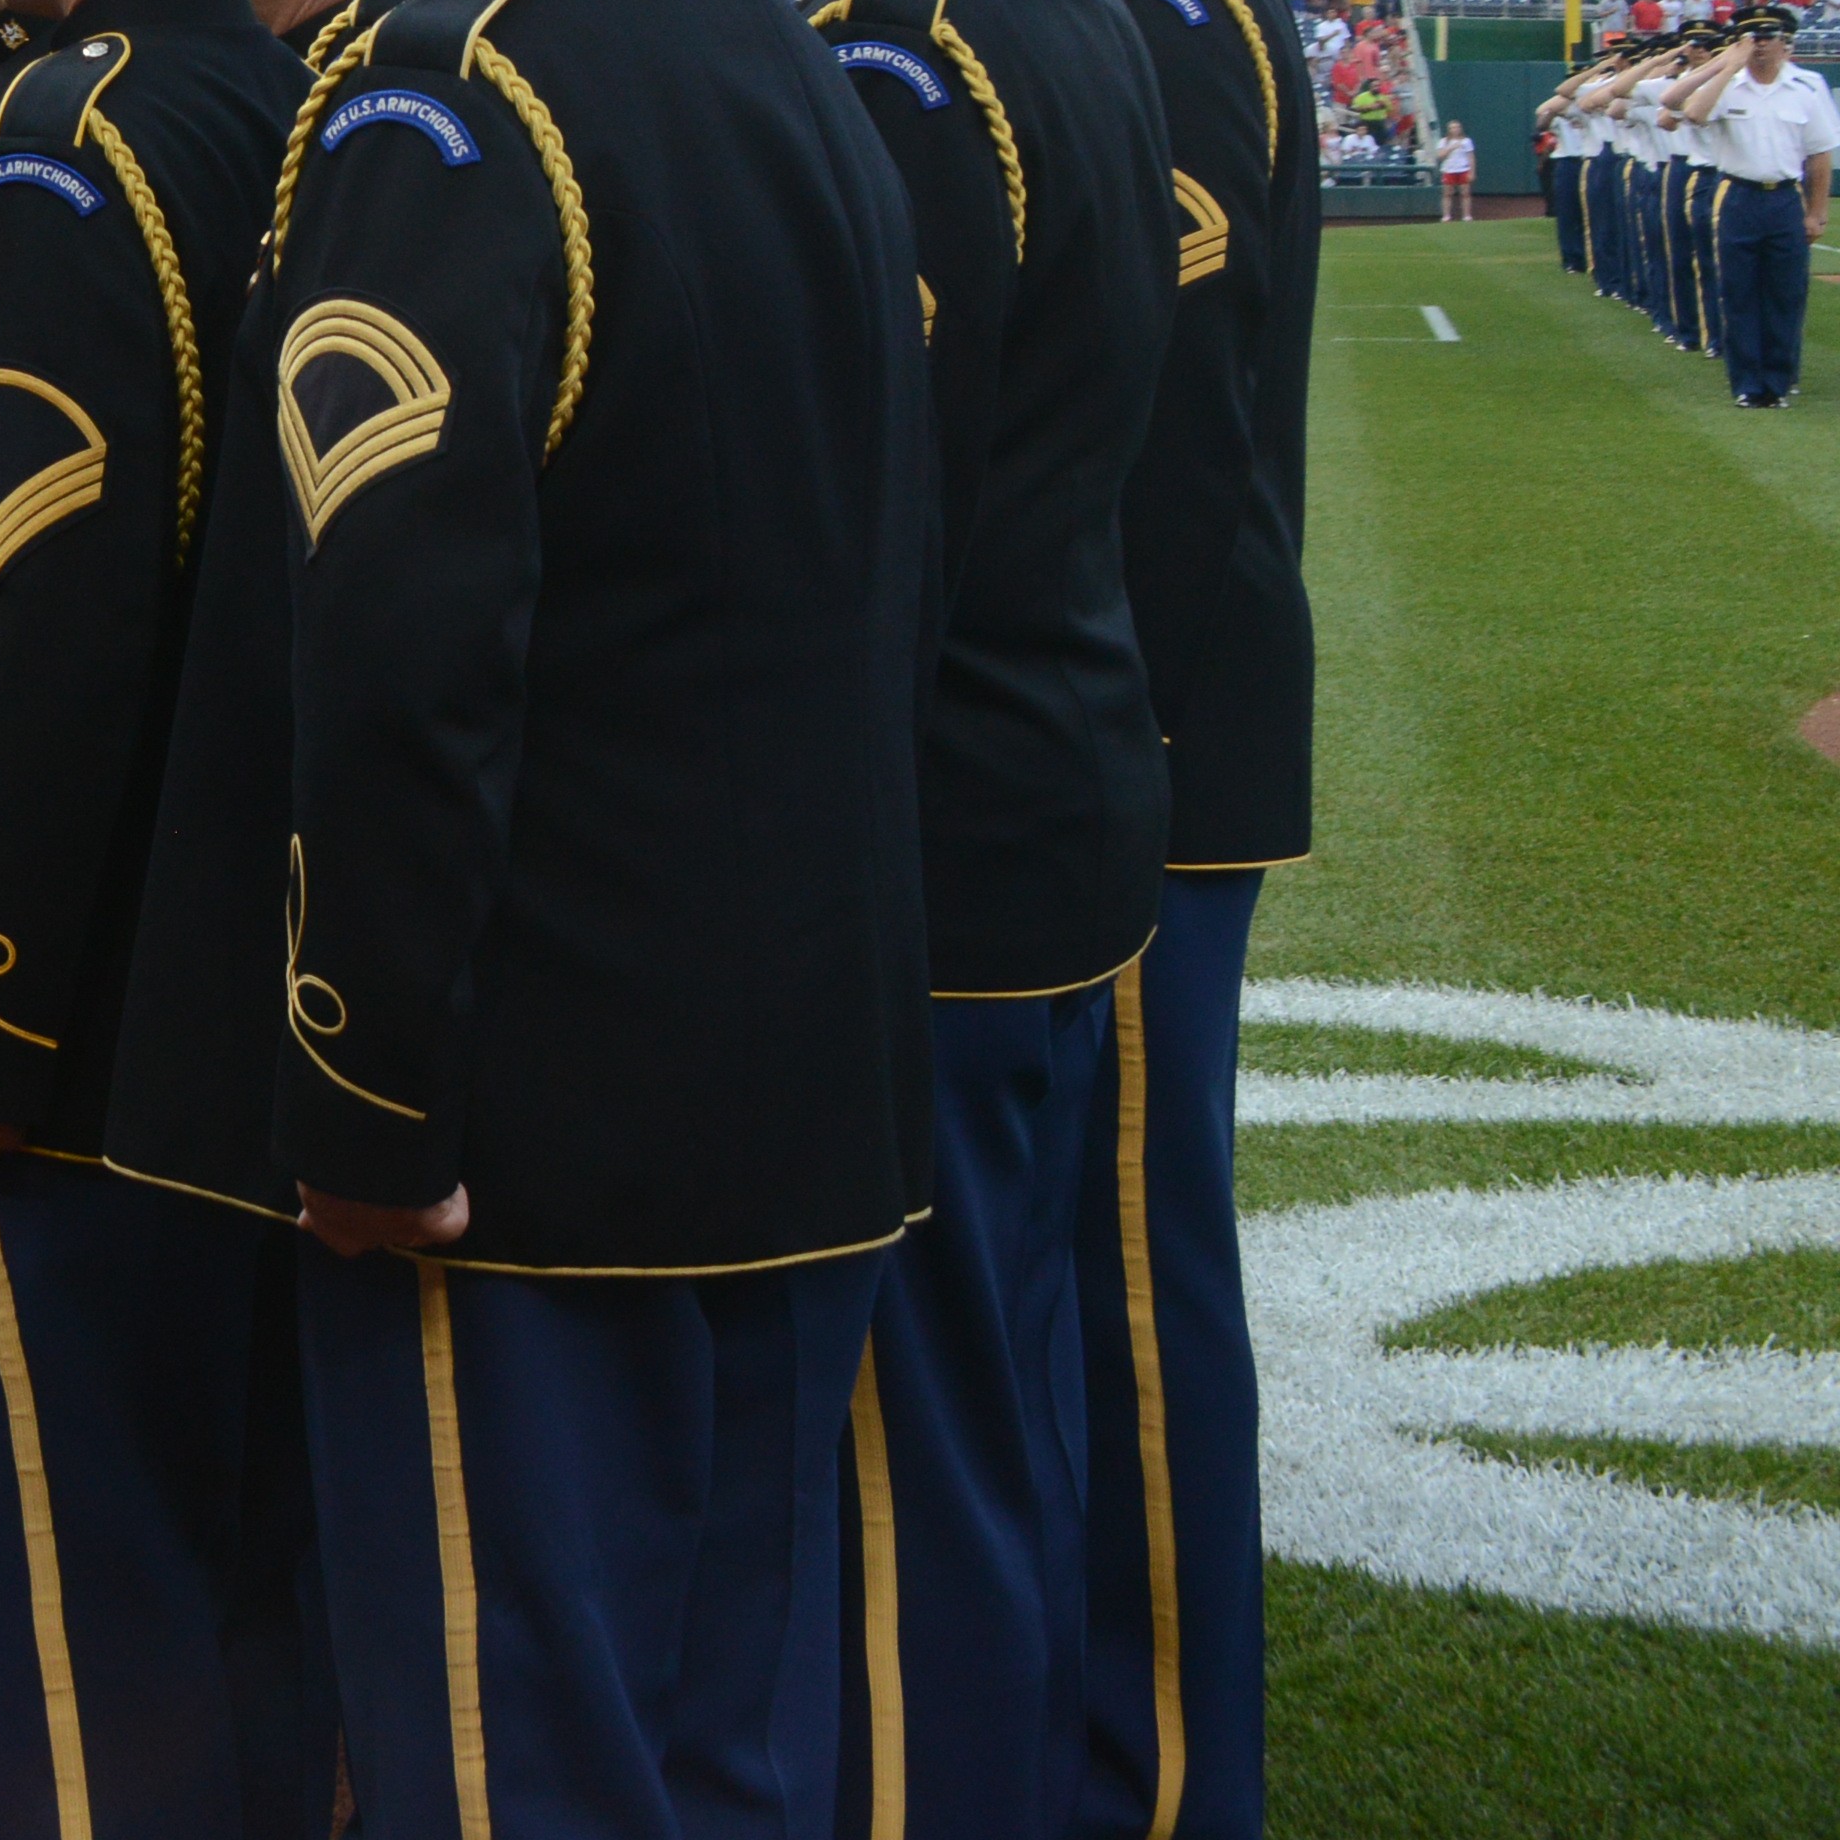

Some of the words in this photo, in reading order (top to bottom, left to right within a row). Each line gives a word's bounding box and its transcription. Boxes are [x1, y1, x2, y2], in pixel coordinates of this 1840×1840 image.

[851, 46, 897, 63] ARMY
[892, 54, 942, 102] CHORUS
[325, 112, 349, 141] THE
[348, 99, 375, 121] U.S.
[375, 97, 422, 115] ARMY
[419, 104, 469, 158] CHORUS
[5, 160, 43, 176] ARMY
[41, 166, 96, 208] CHORUS
